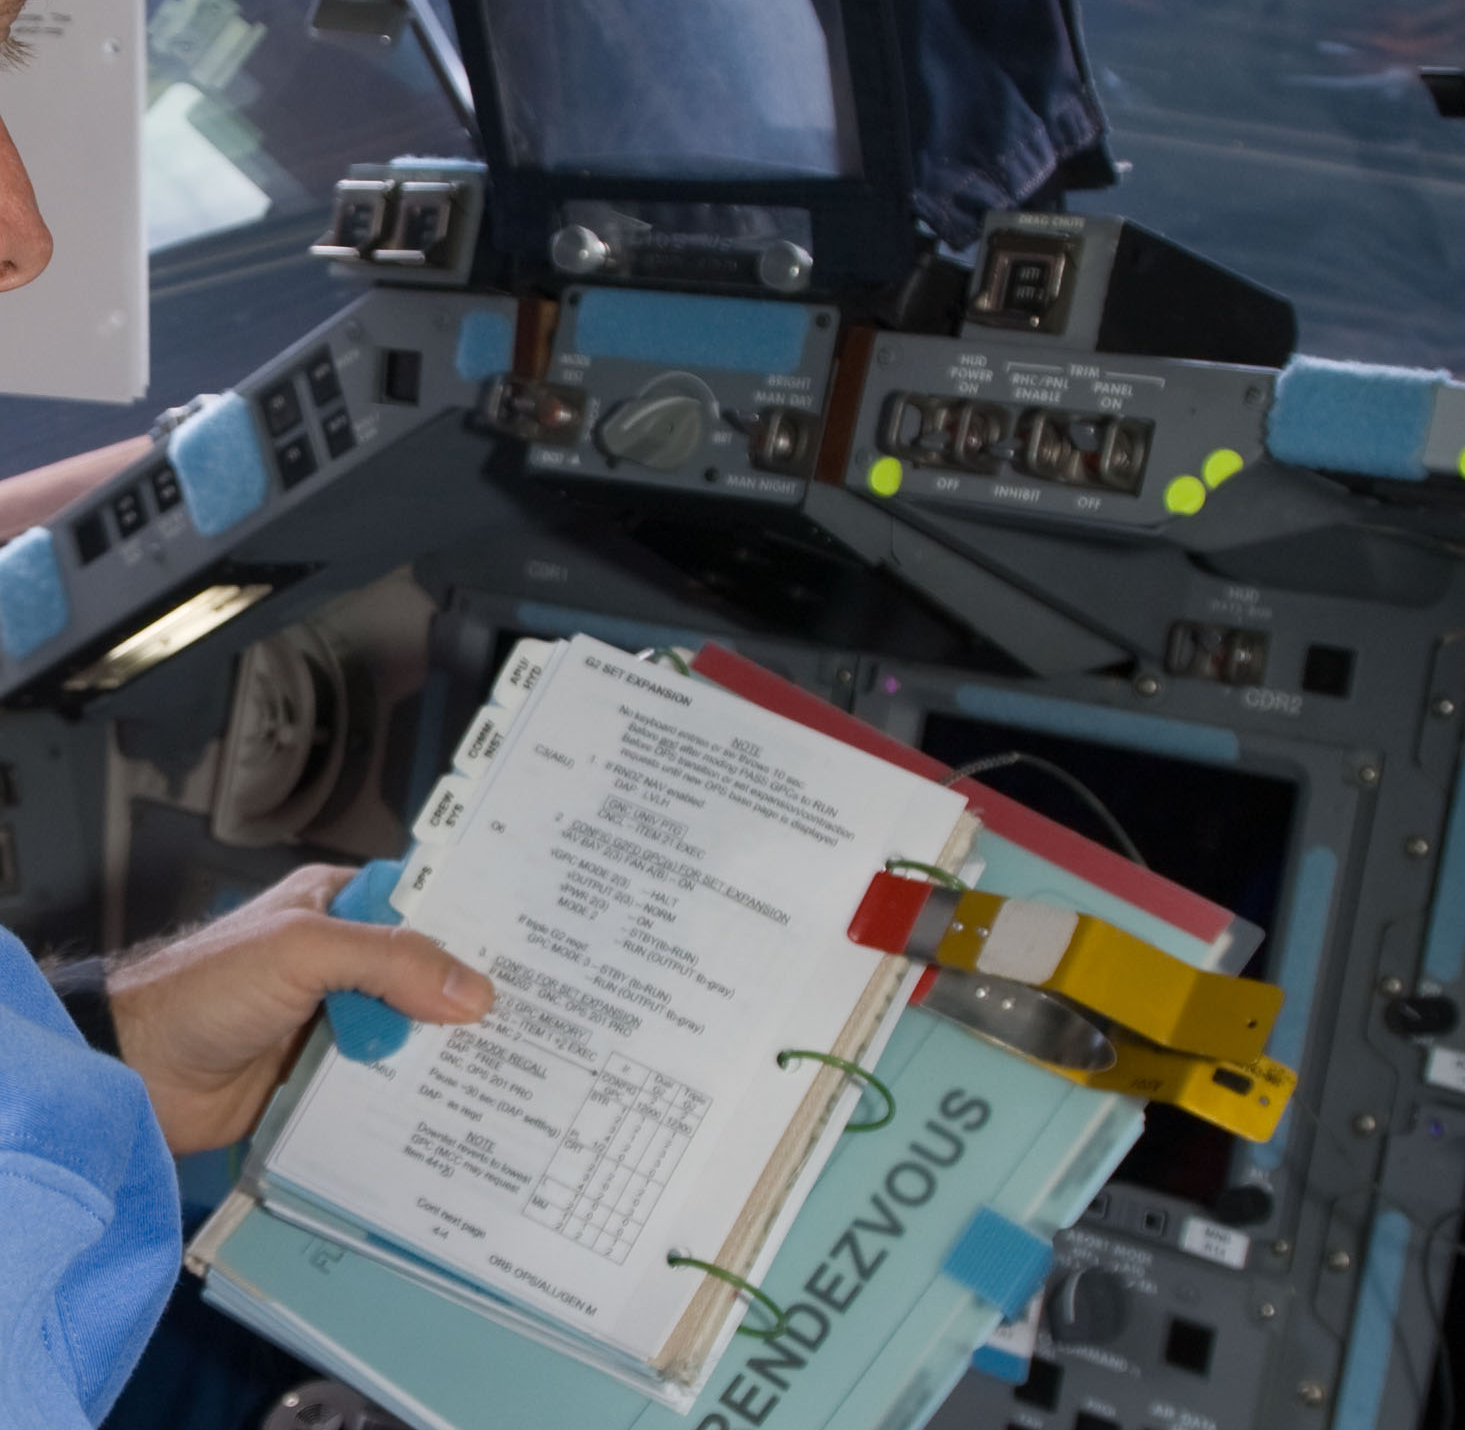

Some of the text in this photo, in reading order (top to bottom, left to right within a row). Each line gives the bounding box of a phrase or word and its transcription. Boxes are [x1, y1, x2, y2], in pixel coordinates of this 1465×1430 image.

[960, 354, 988, 369] HUD
[1069, 364, 1100, 379] TRIM
[767, 375, 812, 391] BRIGHT
[950, 367, 994, 383] POWER
[1011, 372, 1070, 390] RHC/PNL
[959, 382, 979, 395] ON
[1015, 386, 1062, 403] ENABLE
[1094, 380, 1134, 397] PANEL
[753, 391, 815, 408] MAN DAY
[1100, 396, 1123, 410] ON
[727, 475, 797, 495] MAN NIGHT
[936, 476, 960, 491] OFF
[993, 485, 1042, 502] INHIBIT
[1077, 496, 1103, 511] OFF
[584, 656, 692, 706] G2 SET EXPANSION
[1245, 687, 1303, 715] CDR2
[484, 732, 504, 759] INST
[730, 736, 759, 758] NOTE
[642, 776, 666, 791] NAV
[738, 766, 768, 786] PASS
[769, 780, 798, 800] GPCs
[811, 800, 838, 818] RUN
[445, 804, 465, 828] SYS
[608, 799, 685, 838] GNC UNIV PTG
[704, 780, 728, 795] OPS
[752, 802, 778, 819] page
[789, 819, 838, 846] displayed
[634, 822, 705, 859] ITEM 21 EXEC
[412, 865, 433, 892] DPS
[577, 859, 678, 907] MODE HALT
[675, 863, 791, 926] FOR SET EXPANSION
[557, 896, 586, 915] MODE
[642, 902, 676, 922] NORM
[636, 916, 654, 929] ON
[549, 928, 566, 941] G2
[526, 931, 551, 949] GPC
[550, 942, 580, 963] MODE
[622, 939, 647, 956] RUN
[592, 975, 618, 993] RUN
[533, 973, 559, 991] FOR
[557, 984, 581, 1002] SET
[577, 993, 643, 1029] EXPANSION
[513, 1000, 588, 1038] GPC MEMORY
[607, 1019, 632, 1037] PRO
[495, 1023, 513, 1037] MC
[518, 1017, 597, 1062] ITEM EXEC
[474, 1051, 500, 1070] FREE
[475, 1037, 506, 1059] MODE
[506, 1052, 547, 1080] RECALL
[466, 1063, 533, 1100] OPS 201 PRO
[410, 1133, 434, 1150] GPC
[433, 1145, 462, 1165] (MCC
[465, 1130, 494, 1154] NOTE
[440, 1210, 486, 1238] next page
[489, 1254, 598, 1317] ORB OPS/ALL/GEN M
